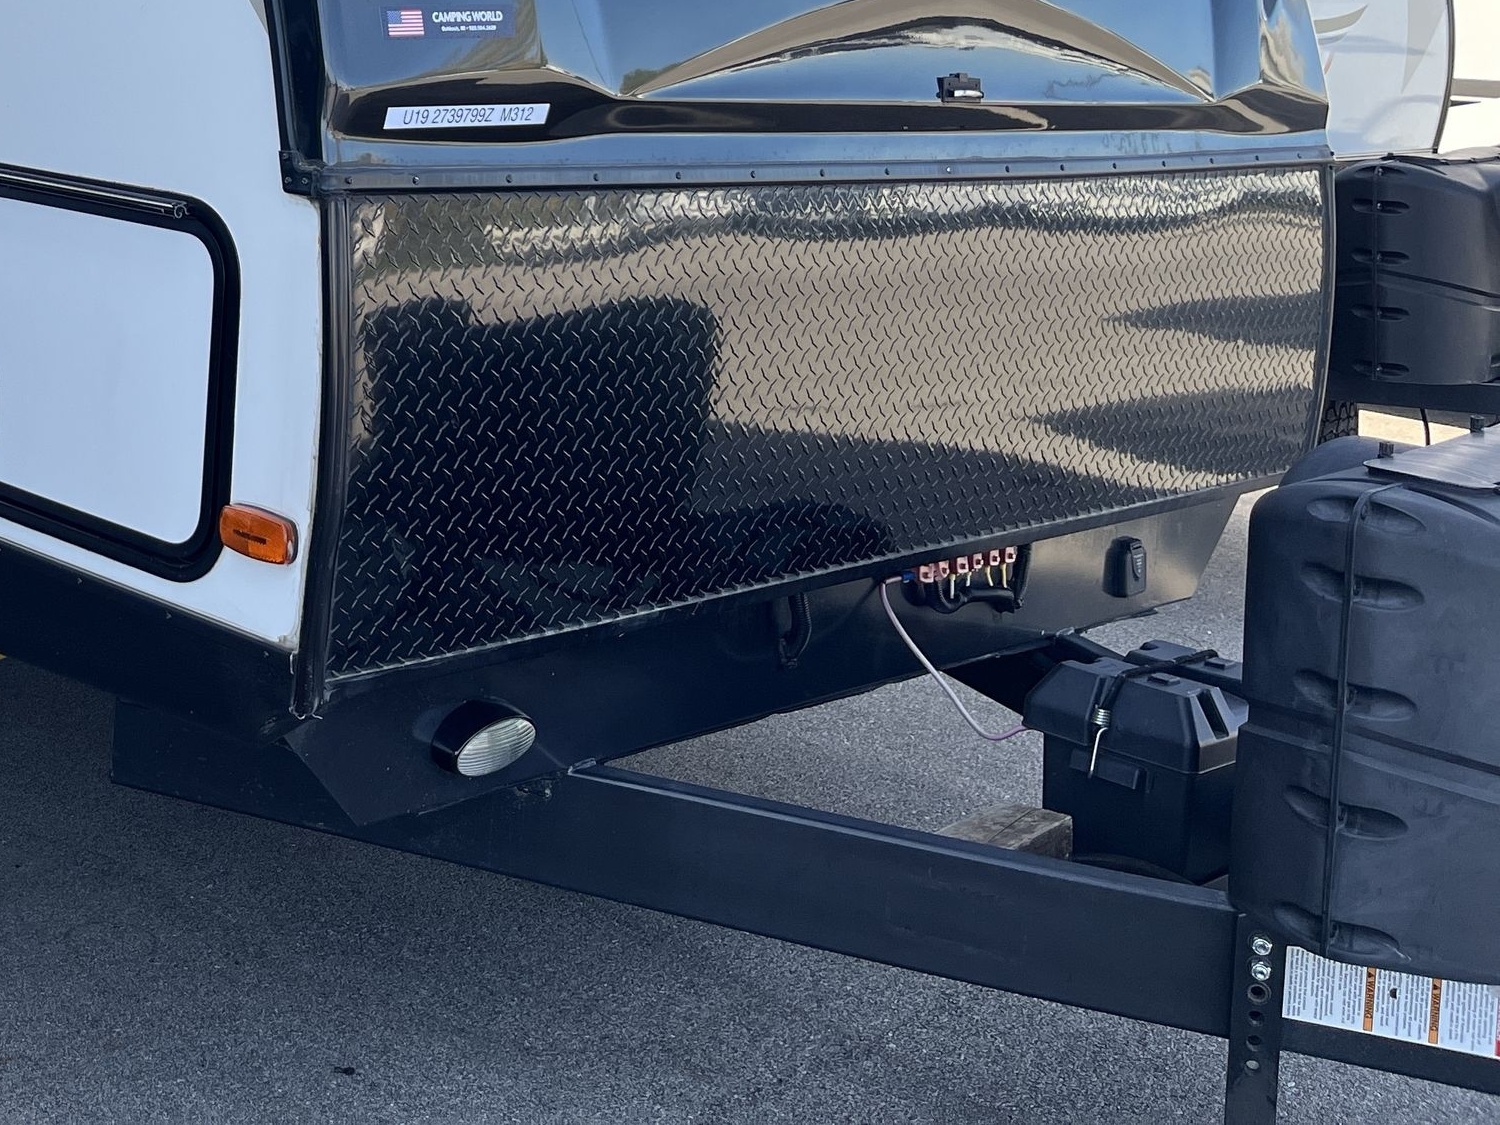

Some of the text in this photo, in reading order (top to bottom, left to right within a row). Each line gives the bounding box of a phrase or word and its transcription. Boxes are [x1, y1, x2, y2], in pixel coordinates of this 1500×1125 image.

[431, 10, 504, 23] CAMPING WORLD
[403, 106, 535, 125] U19 2739799Z M312
[1365, 979, 1376, 1019] WARNING
[1430, 993, 1441, 1032] WARNING
